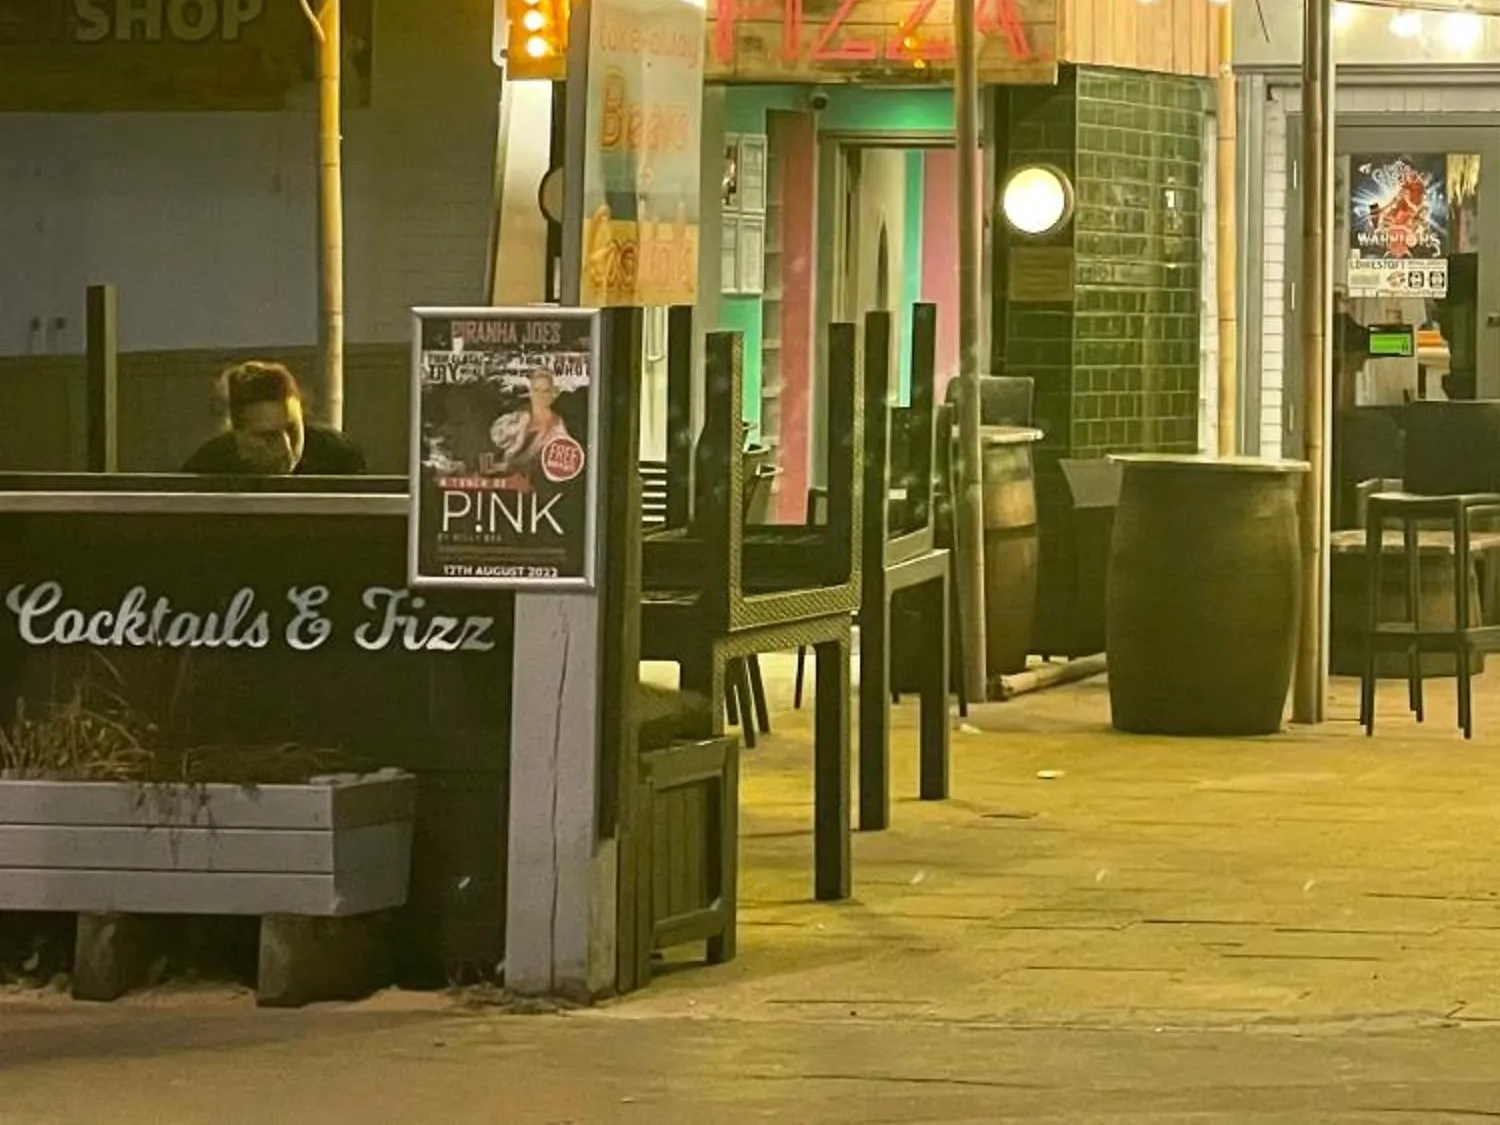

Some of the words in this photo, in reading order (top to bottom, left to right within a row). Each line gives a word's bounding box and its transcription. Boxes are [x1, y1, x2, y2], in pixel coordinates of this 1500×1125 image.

[442, 489, 565, 535] P!NK
[475, 565, 525, 577] AUGUST
[6, 580, 271, 648] Cocktails
[354, 586, 497, 651] Fizz
